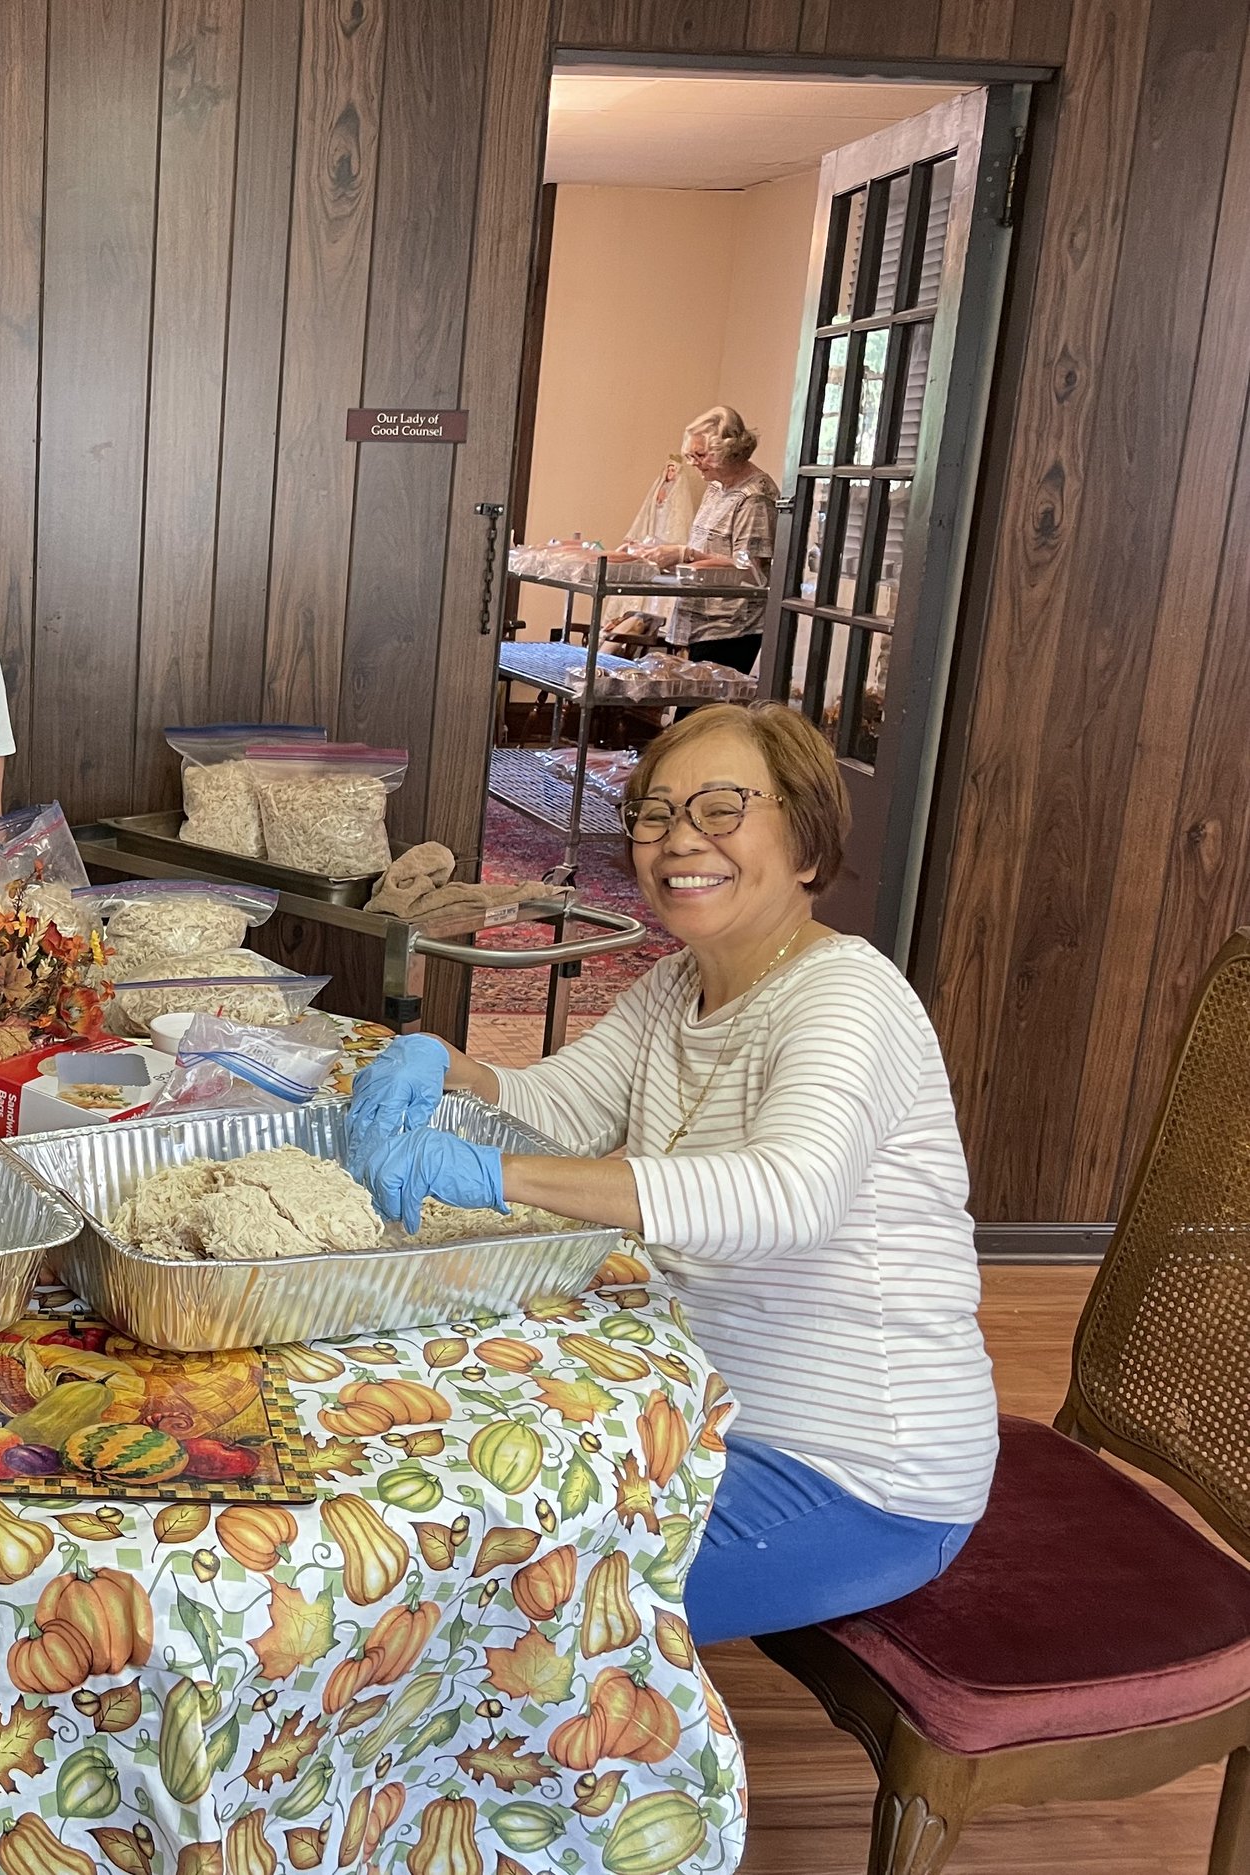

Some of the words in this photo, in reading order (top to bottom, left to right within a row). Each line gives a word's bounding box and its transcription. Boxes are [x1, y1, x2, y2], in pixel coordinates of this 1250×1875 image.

[377, 413, 398, 424] Our
[400, 413, 426, 427] Lady
[428, 413, 440, 425] of
[371, 425, 399, 436] Good
[402, 426, 443, 437] Counsel
[5, 1093, 17, 1138] Sandwic
